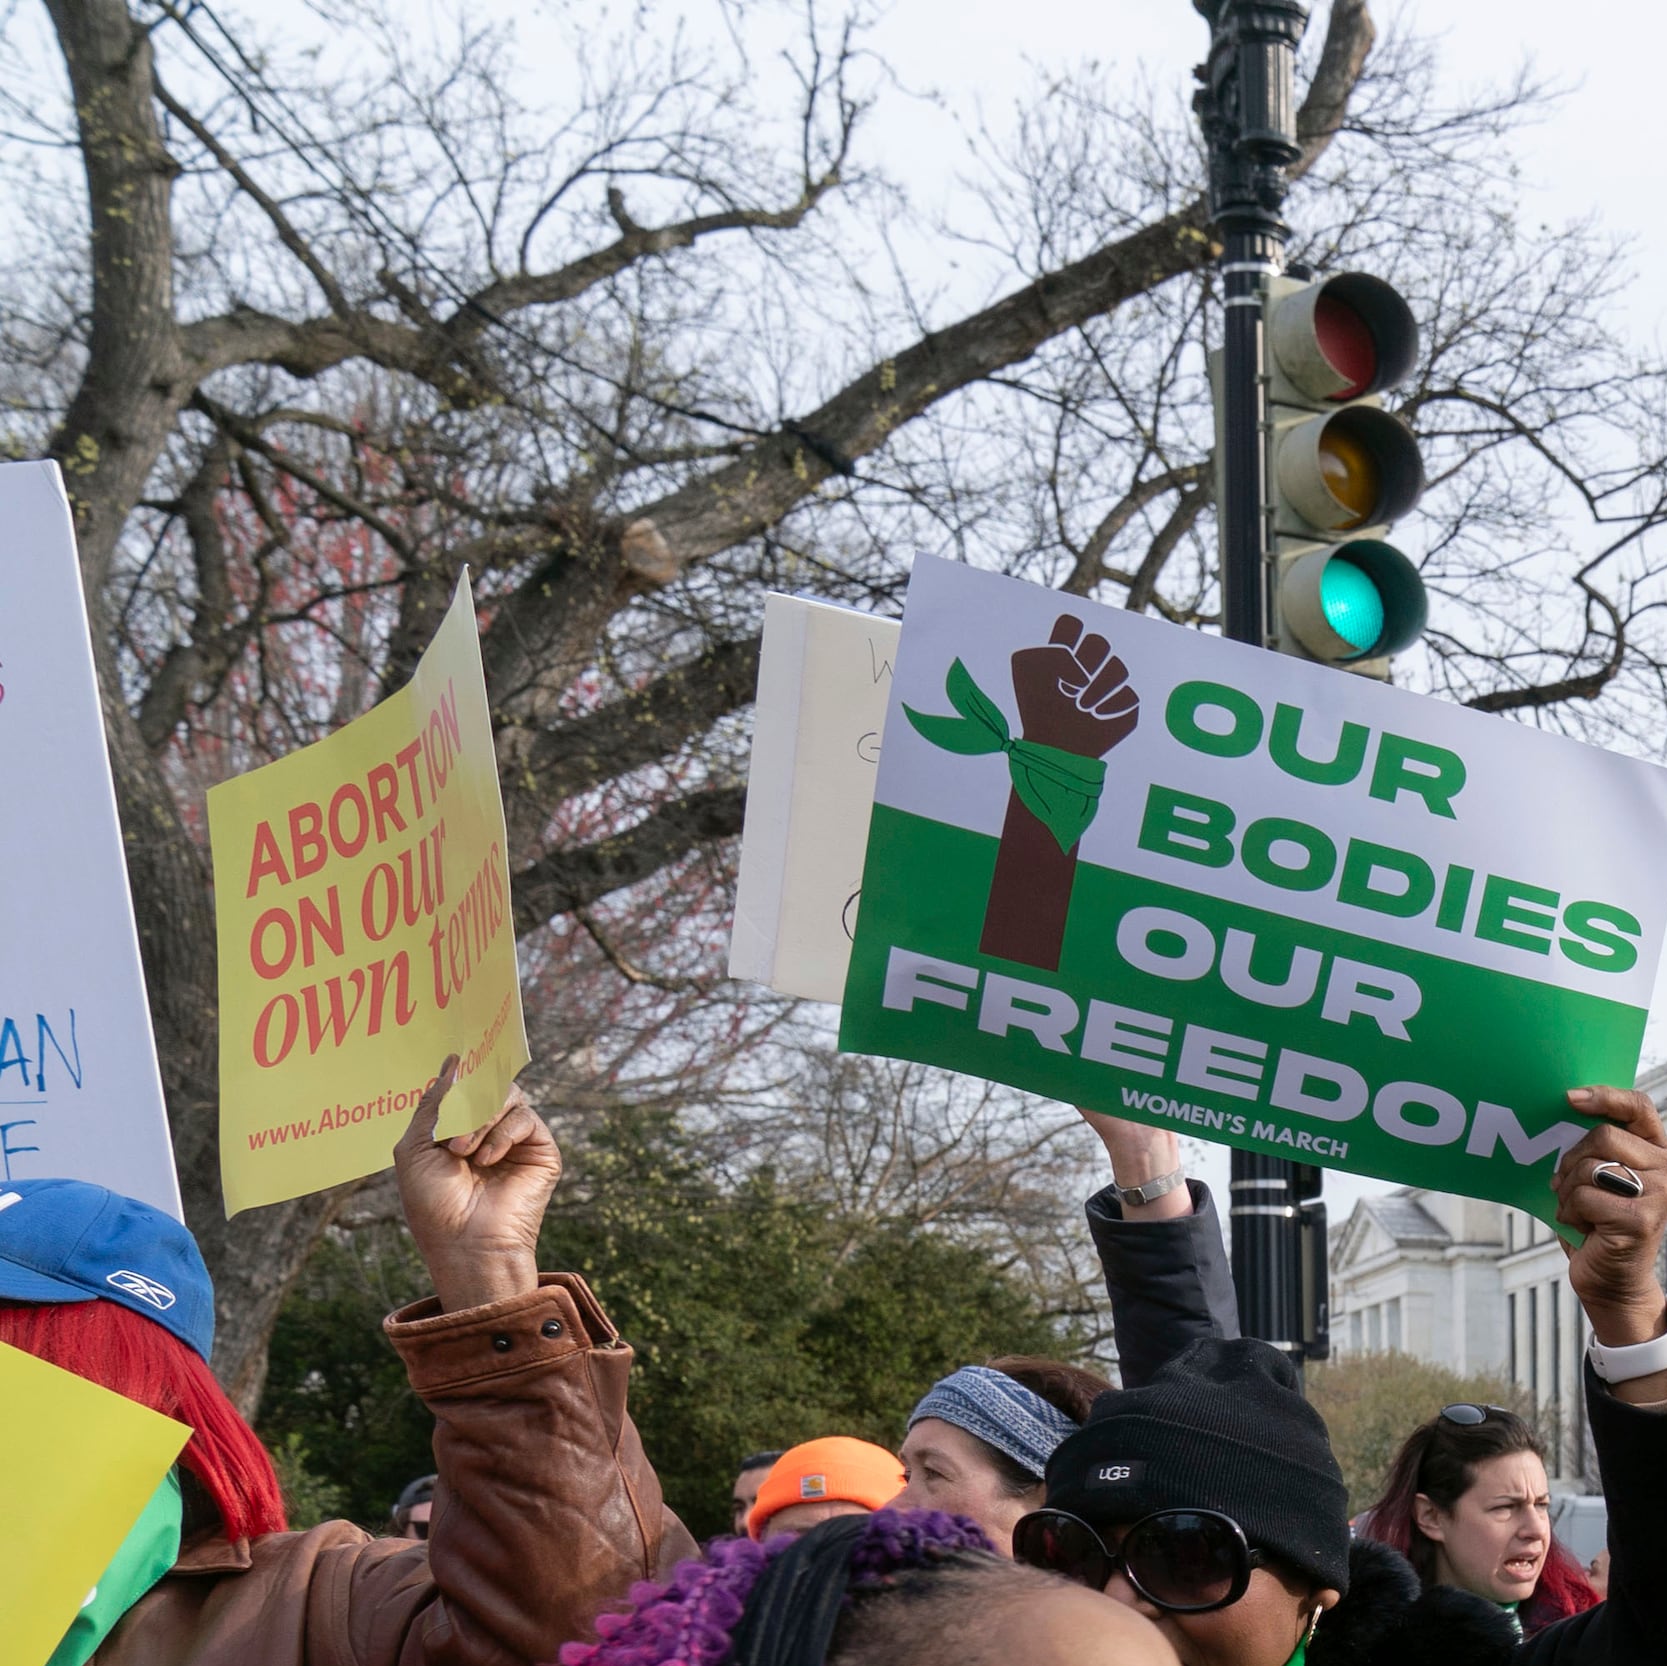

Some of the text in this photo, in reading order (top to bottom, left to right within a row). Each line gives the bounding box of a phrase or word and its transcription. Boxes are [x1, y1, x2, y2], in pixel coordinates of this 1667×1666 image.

[246, 676, 462, 900] ABORTION
[1164, 679, 1469, 820] OUR
[250, 817, 447, 980] ON our
[253, 841, 505, 1069] own terms
[1137, 783, 1643, 974] BODIES
[1116, 906, 1423, 1041] OUR
[881, 945, 1590, 1174] FREEDOM
[1251, 1120, 1349, 1160] MARCH
[1099, 1466, 1131, 1481] UGG
